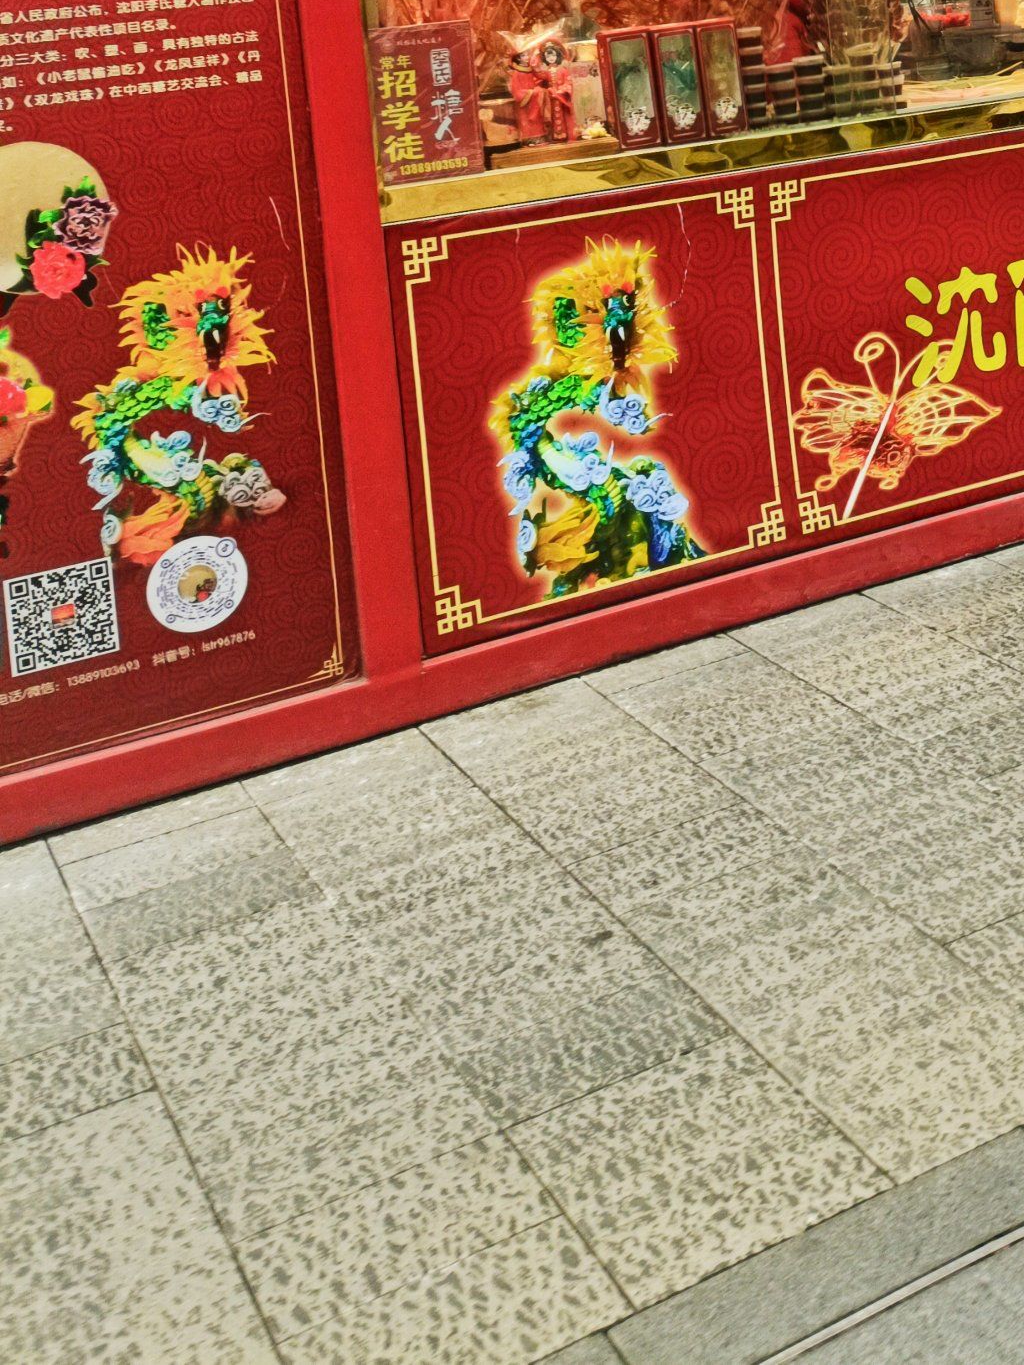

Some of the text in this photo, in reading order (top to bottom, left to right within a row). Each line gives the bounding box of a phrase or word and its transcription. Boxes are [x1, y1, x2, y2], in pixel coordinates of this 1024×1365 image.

[379, 54, 412, 70] 常年
[377, 69, 424, 163] 招学徒
